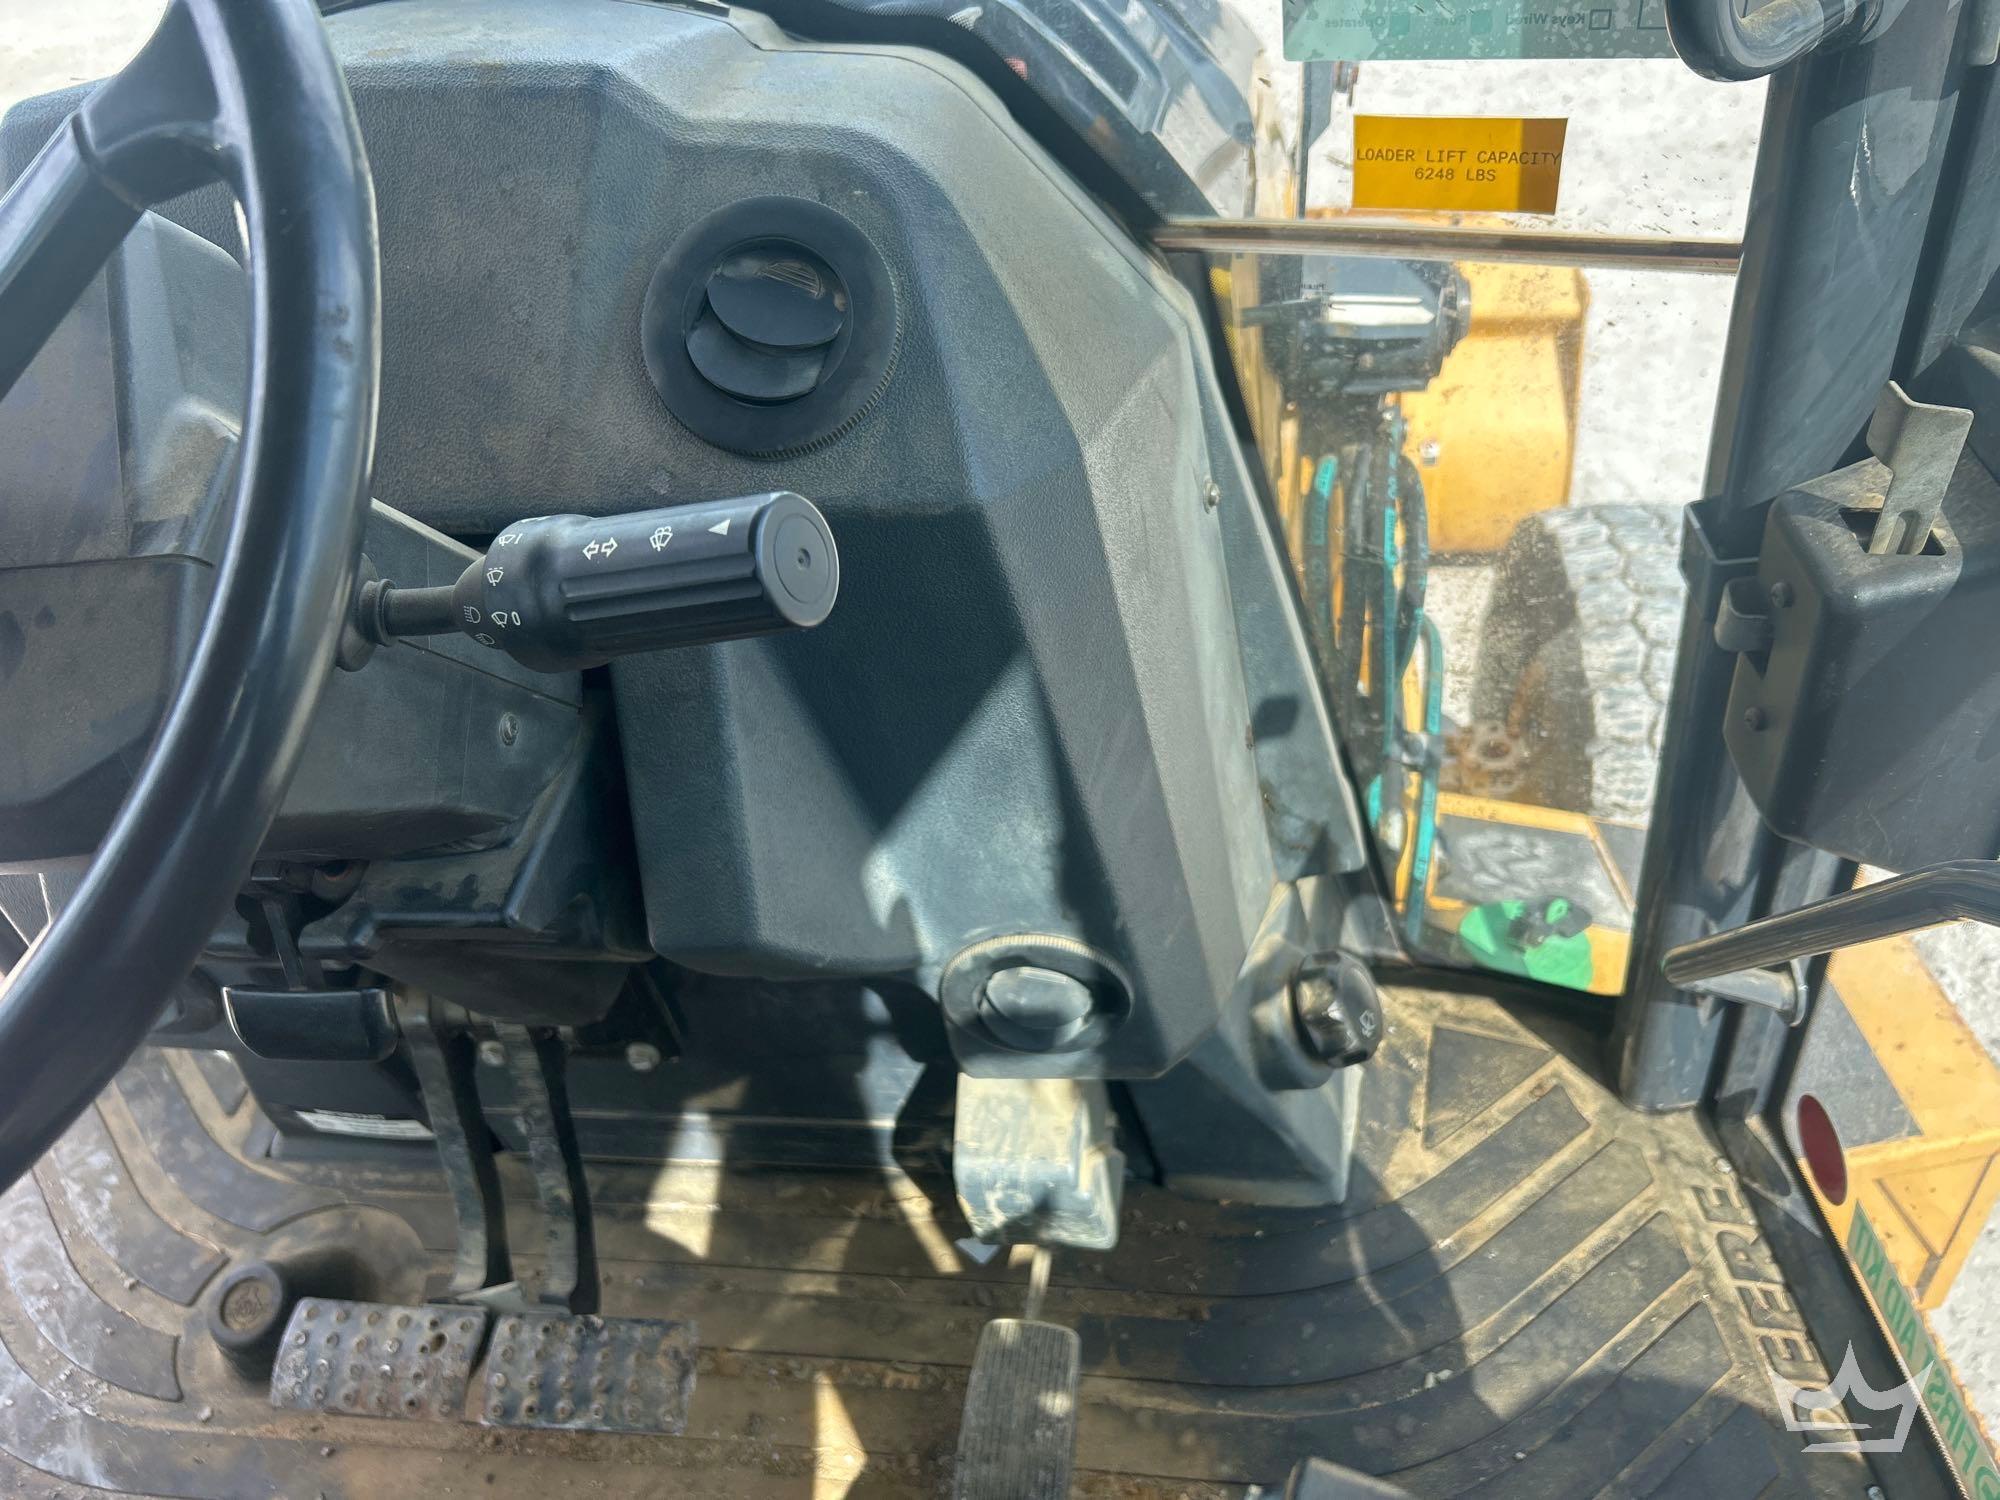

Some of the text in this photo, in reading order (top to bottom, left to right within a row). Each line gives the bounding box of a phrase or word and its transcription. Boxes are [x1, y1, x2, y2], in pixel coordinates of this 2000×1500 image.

[1356, 148, 1562, 167] LOADER LIFT CAPACITY
[1414, 167, 1497, 182] 6248 LBS
